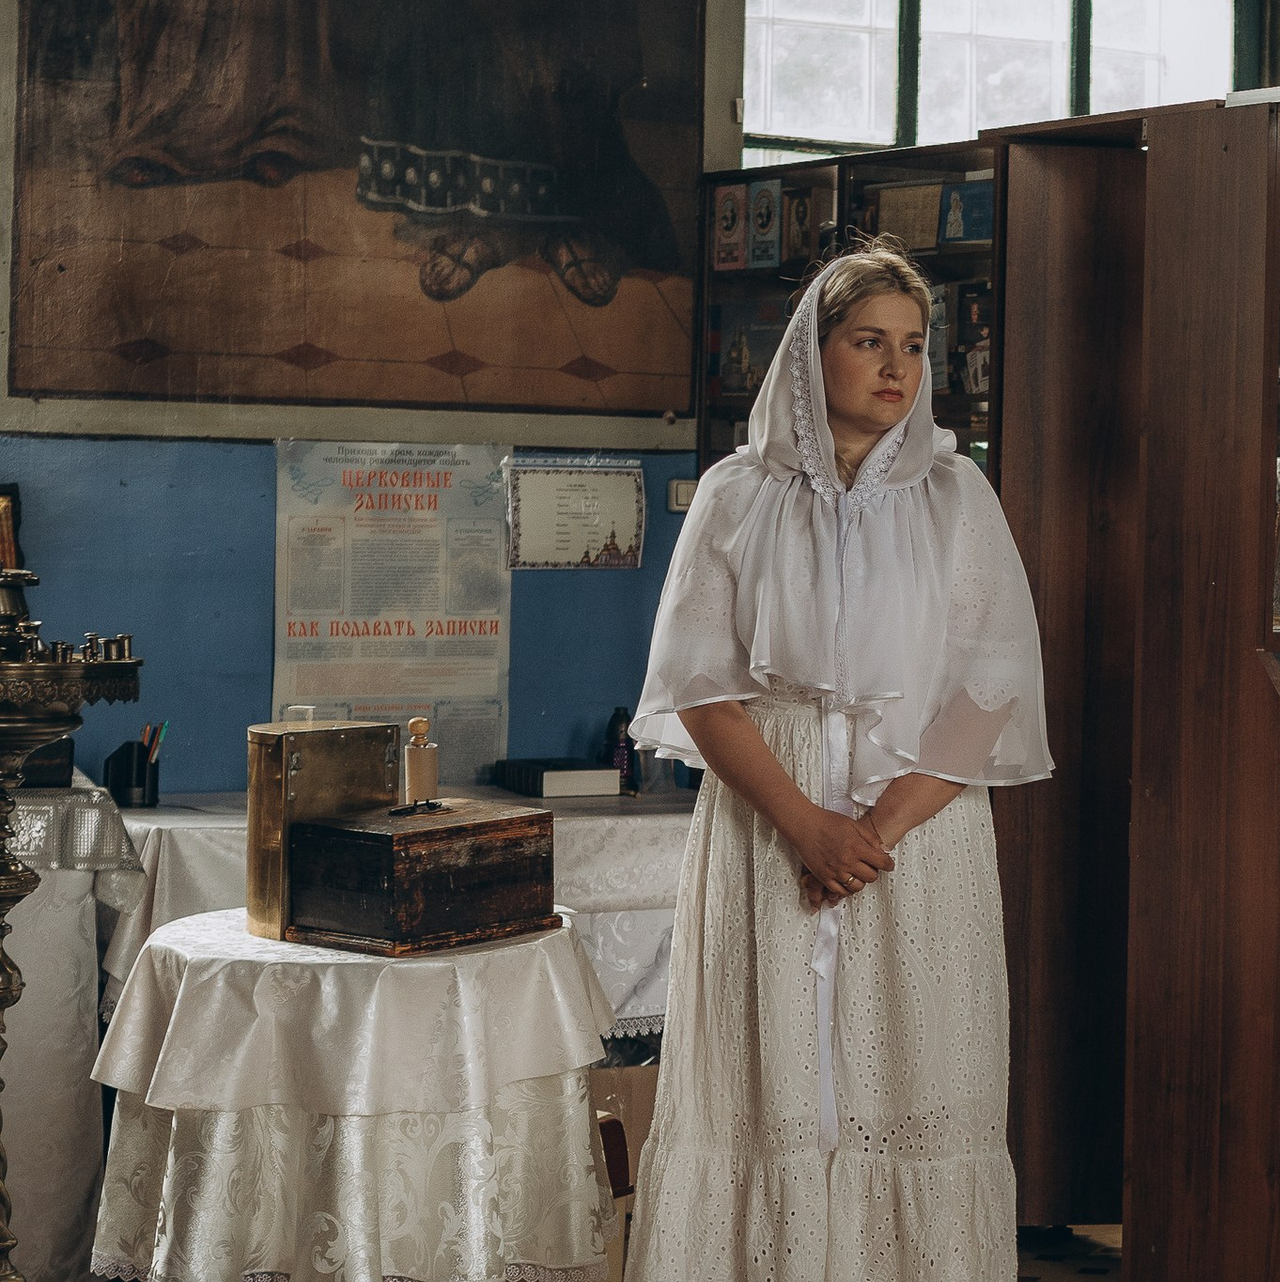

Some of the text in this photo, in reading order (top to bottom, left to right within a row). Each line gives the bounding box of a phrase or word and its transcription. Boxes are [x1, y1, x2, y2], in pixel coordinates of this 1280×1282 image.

[341, 469, 453, 490] ЦЕРКОВНЫЕ
[354, 492, 439, 513] ЗАПИСКИ
[287, 619, 500, 639] КАК ПОДАВАТЬ ЗАПИСКИ
